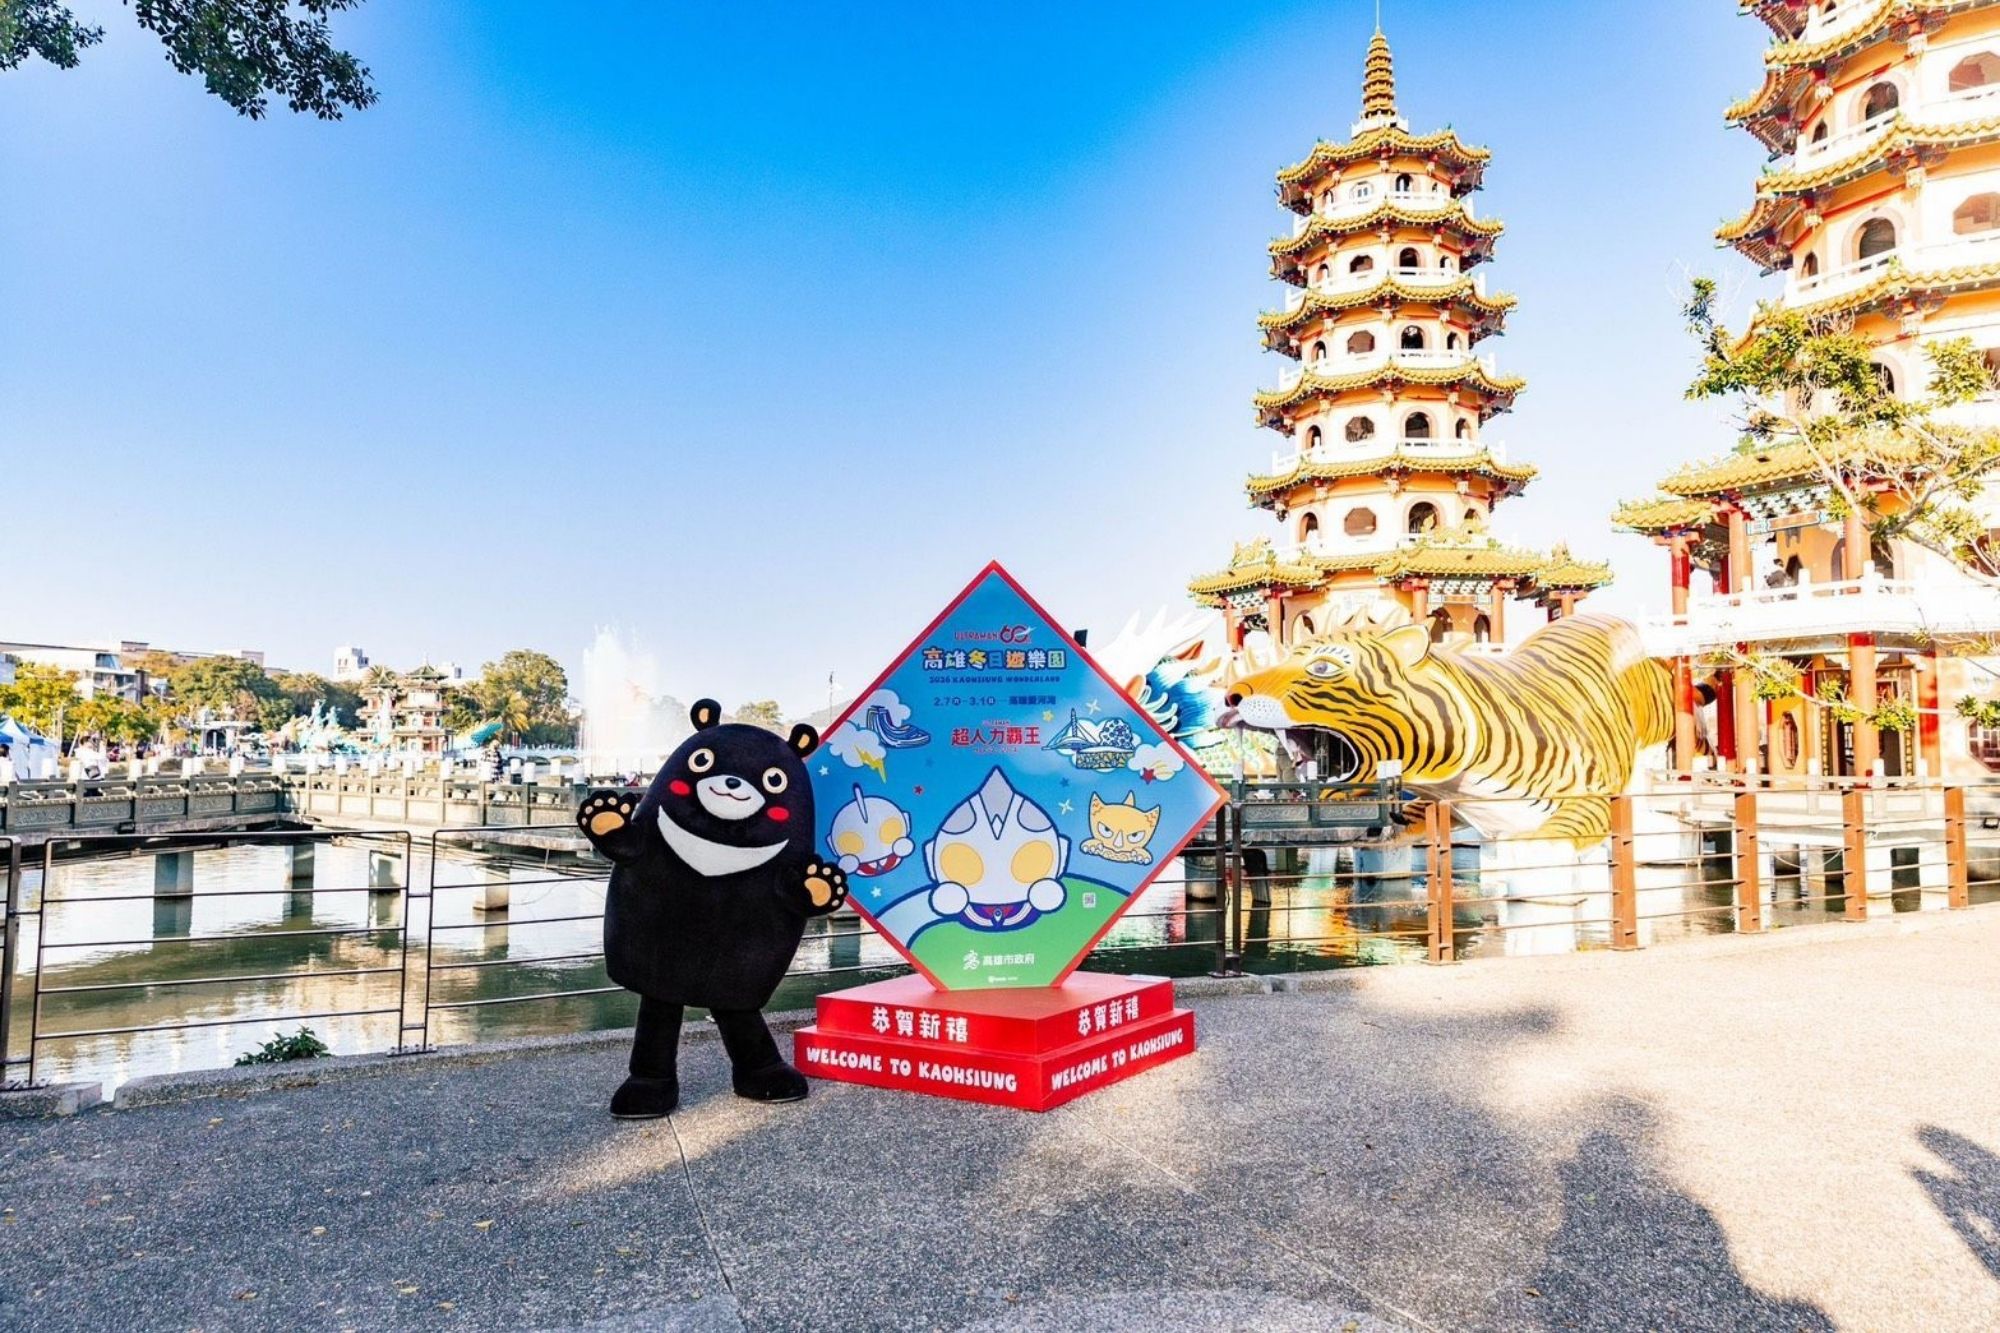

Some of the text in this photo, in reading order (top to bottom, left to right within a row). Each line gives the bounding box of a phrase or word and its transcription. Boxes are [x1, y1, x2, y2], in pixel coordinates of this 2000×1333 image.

[923, 646, 1065, 670] 高雄冬日遊樂園
[952, 727, 1041, 746] 超人力霸王
[982, 953, 1035, 966] 高雄市政府
[871, 1006, 969, 1043] 恭賀新禧
[1078, 995, 1139, 1036] 恭賀新禧
[806, 1047, 1018, 1092] WELCOME TO KAOHSIUNG
[1051, 1028, 1184, 1091] WELCOME TO KAOHSIUNG
